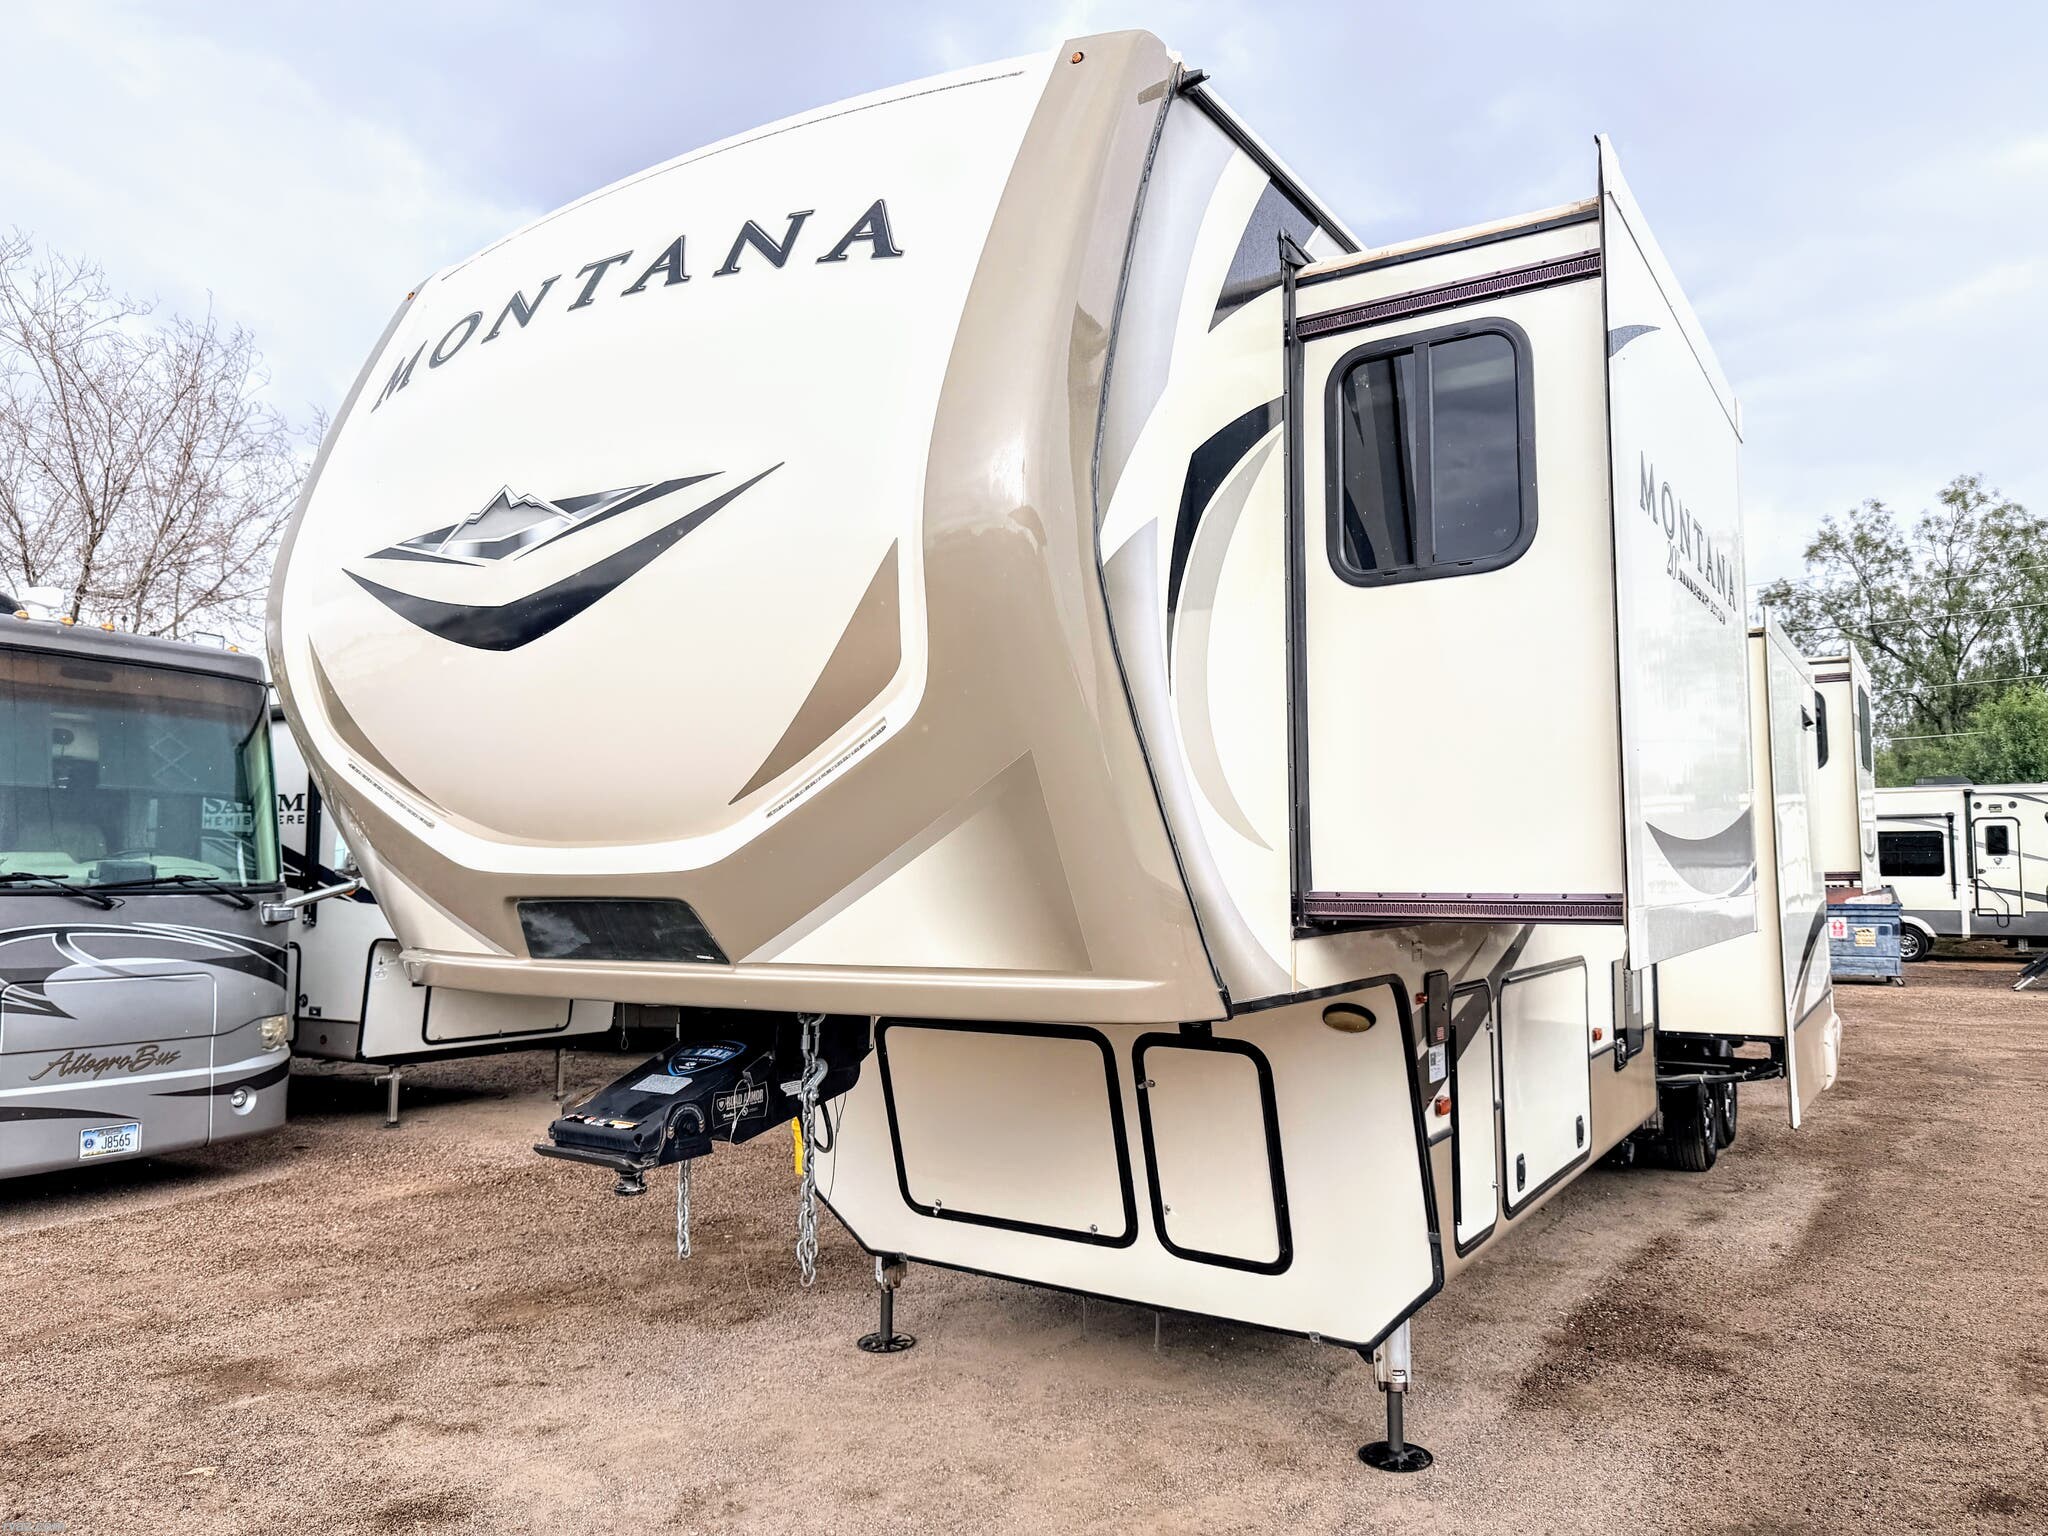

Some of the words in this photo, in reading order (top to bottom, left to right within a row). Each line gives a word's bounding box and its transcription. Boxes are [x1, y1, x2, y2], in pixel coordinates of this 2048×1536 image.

[370, 198, 905, 414] MONTANA
[1639, 450, 1737, 613] MONTANA
[204, 793, 306, 814] SAM
[203, 815, 306, 827] HEMISERE
[101, 1133, 131, 1150] J8565
